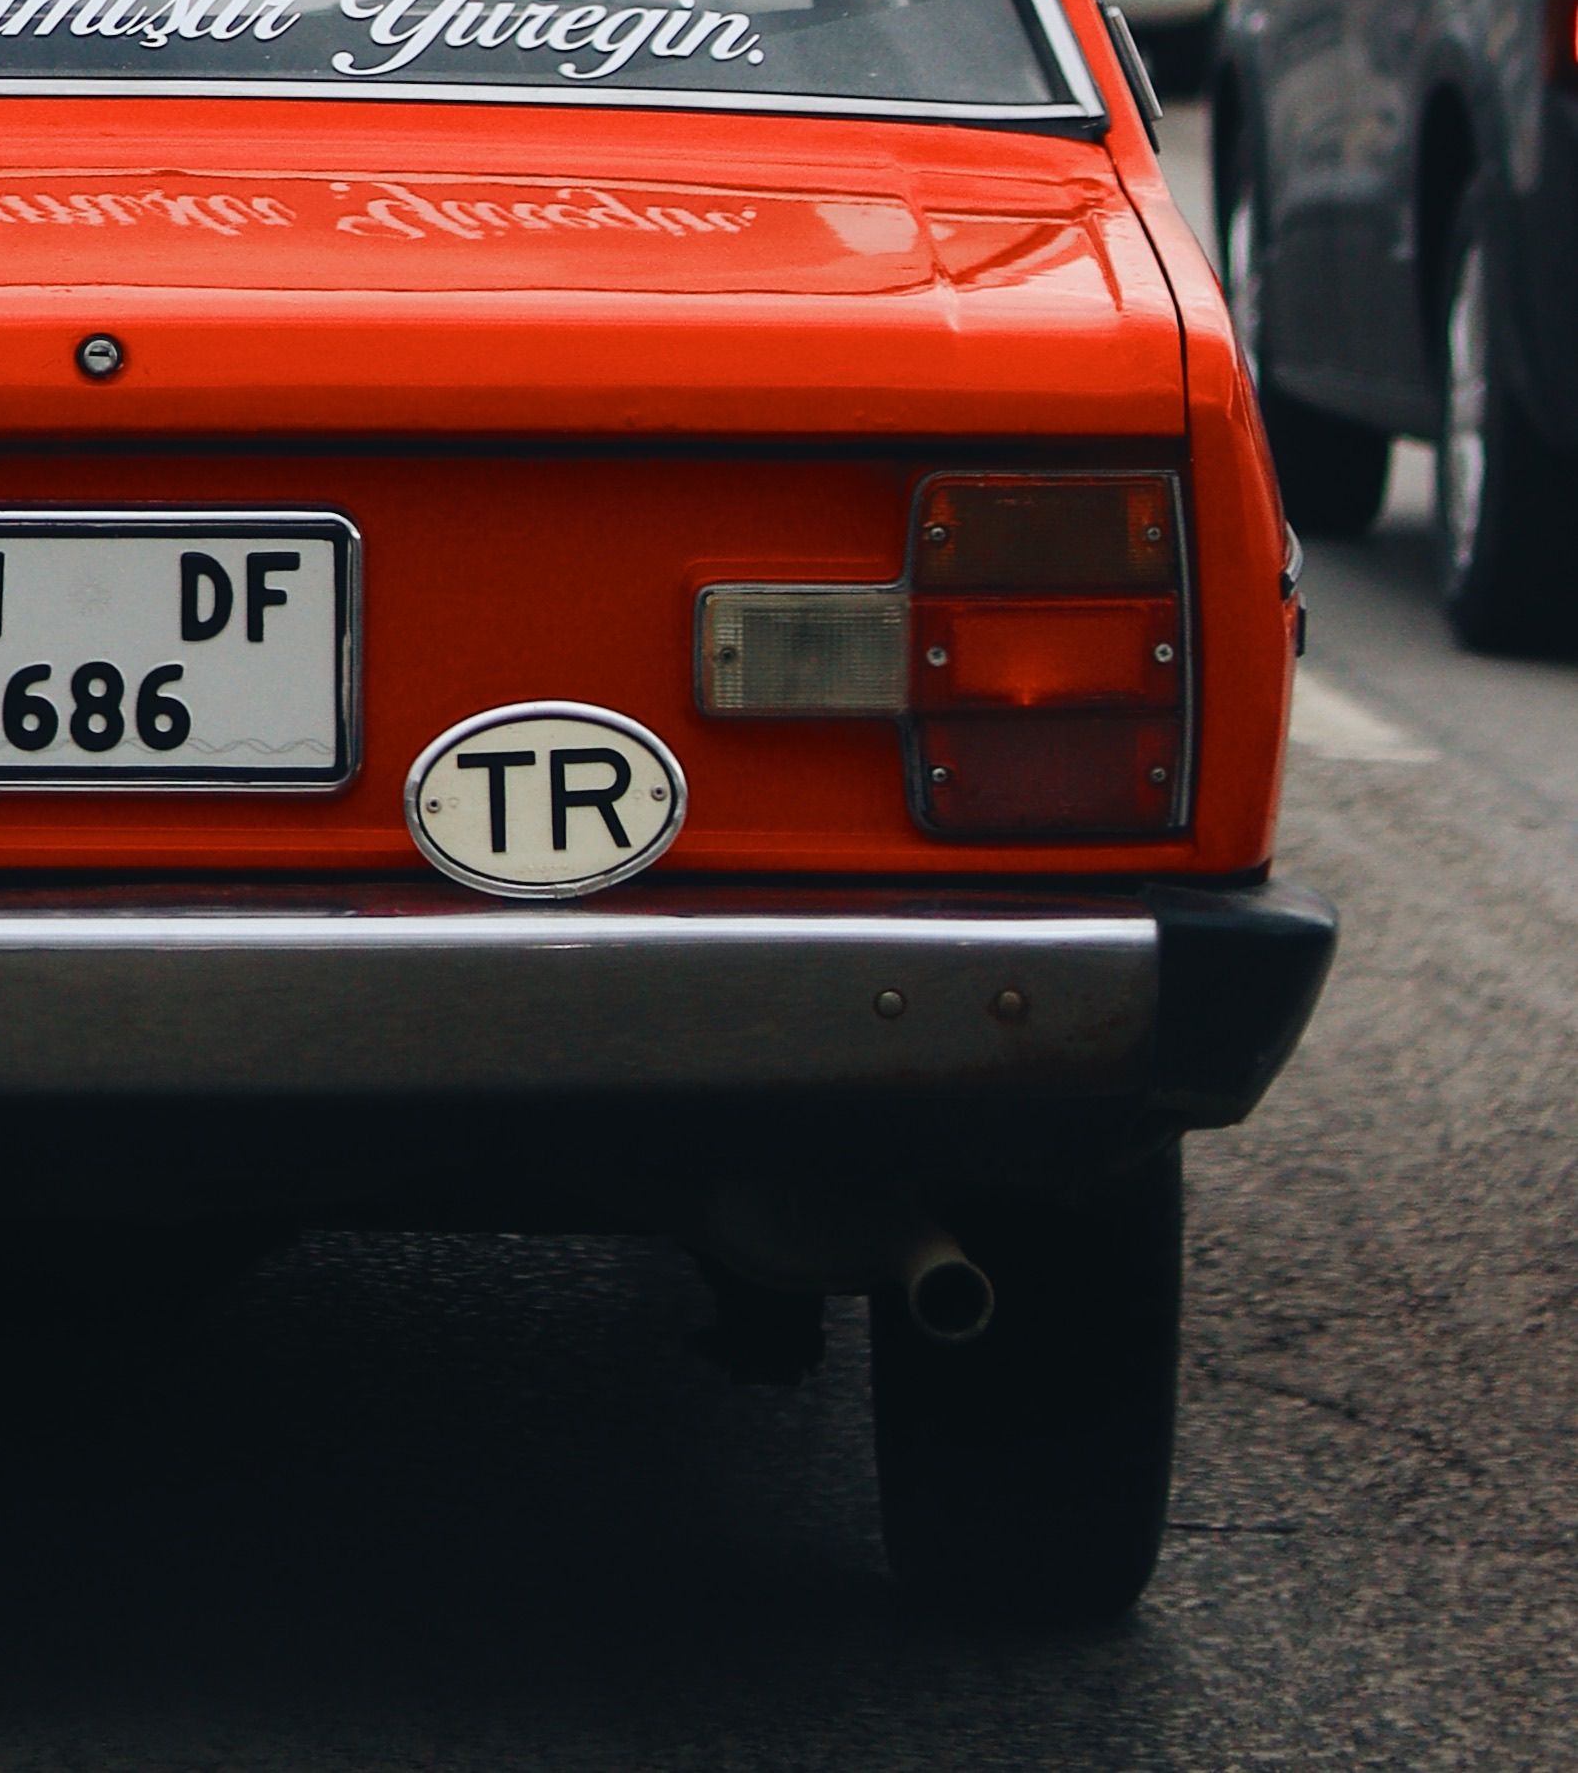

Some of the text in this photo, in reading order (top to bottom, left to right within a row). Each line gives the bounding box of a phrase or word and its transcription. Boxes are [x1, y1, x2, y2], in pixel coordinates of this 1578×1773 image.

[180, 551, 301, 642] DF
[2, 661, 191, 752] 686
[457, 747, 632, 853] TR
